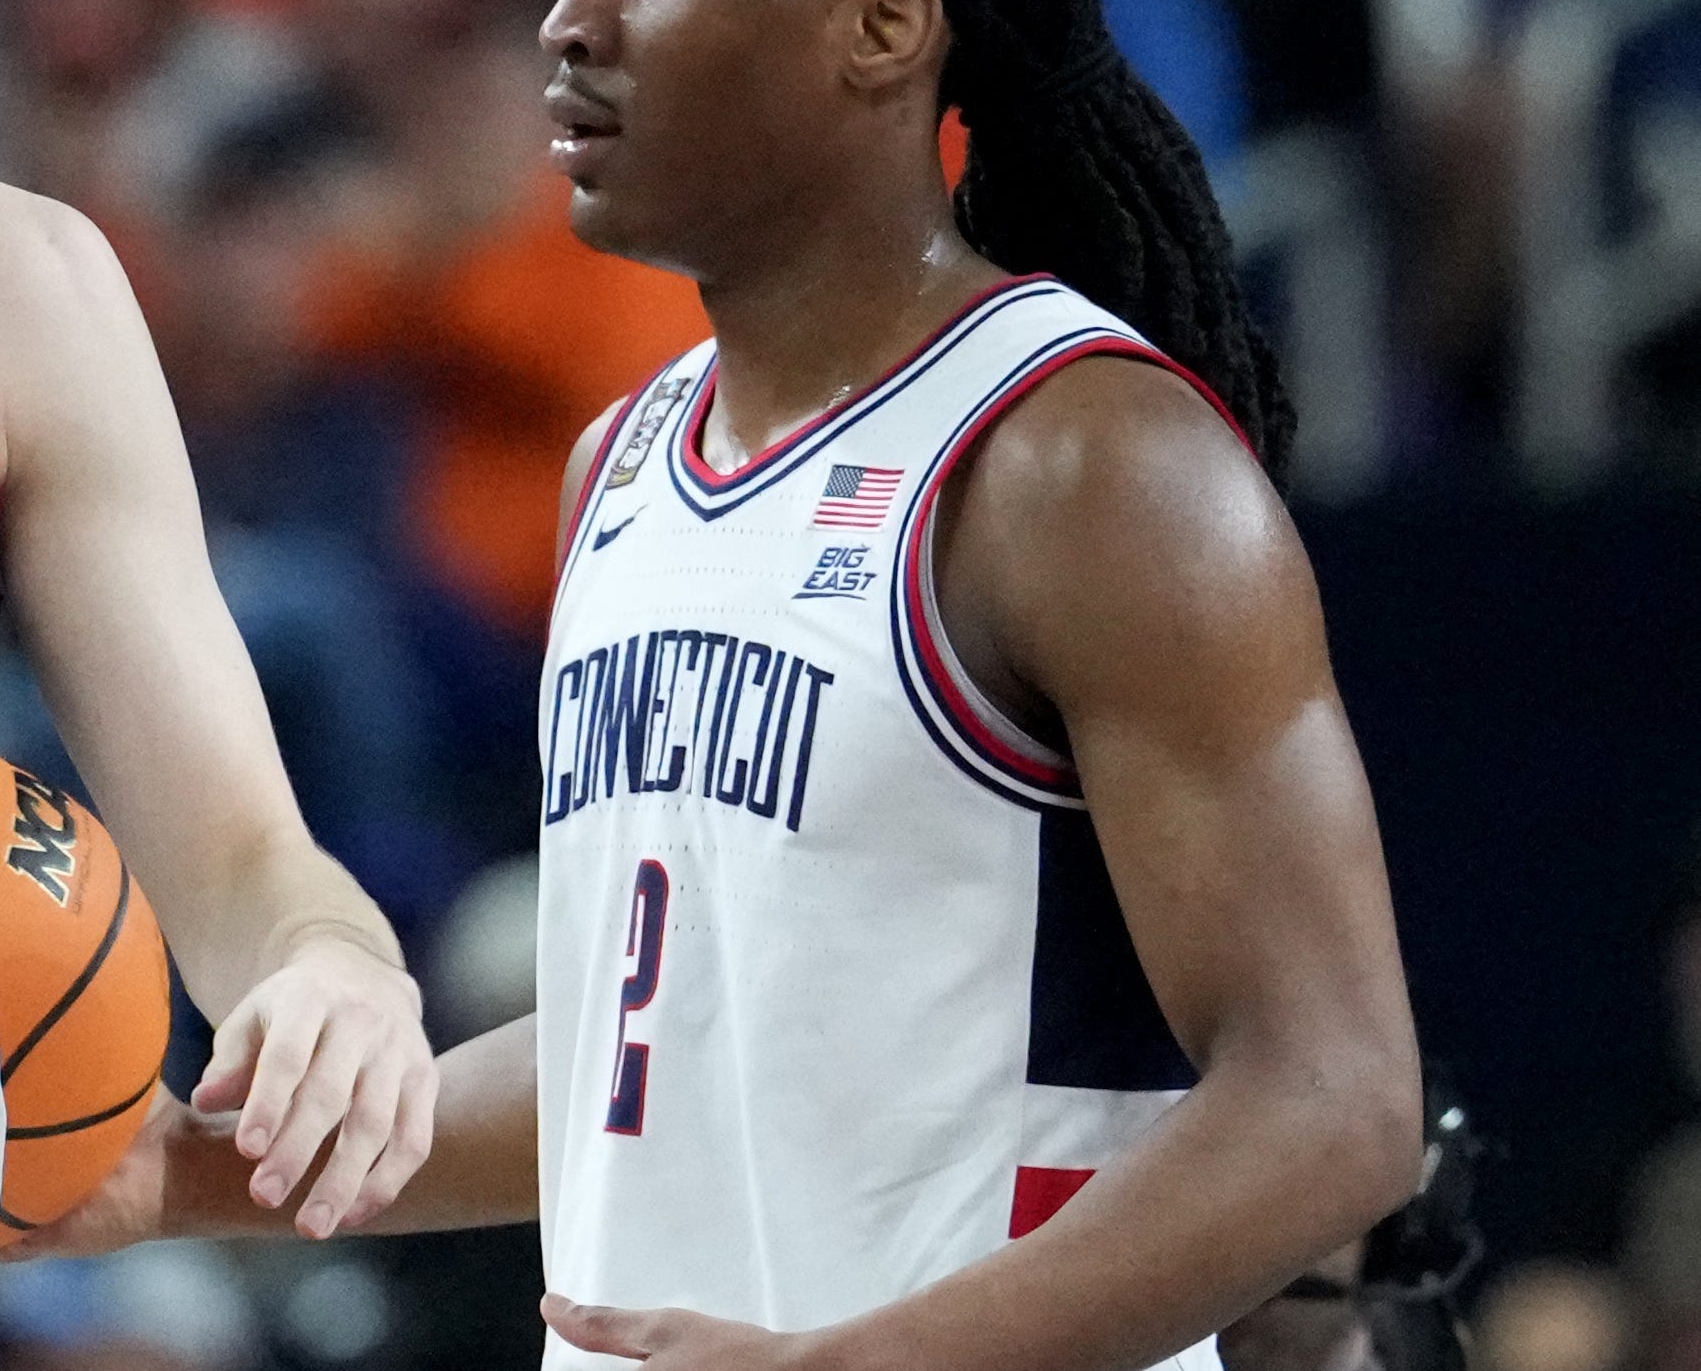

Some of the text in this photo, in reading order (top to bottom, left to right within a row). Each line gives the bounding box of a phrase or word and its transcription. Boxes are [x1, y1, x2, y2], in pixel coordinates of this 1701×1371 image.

[801, 570, 878, 591] EAST
[815, 545, 871, 569] BIG
[544, 629, 836, 833] CONNECTICUT
[602, 858, 670, 1137] 2
